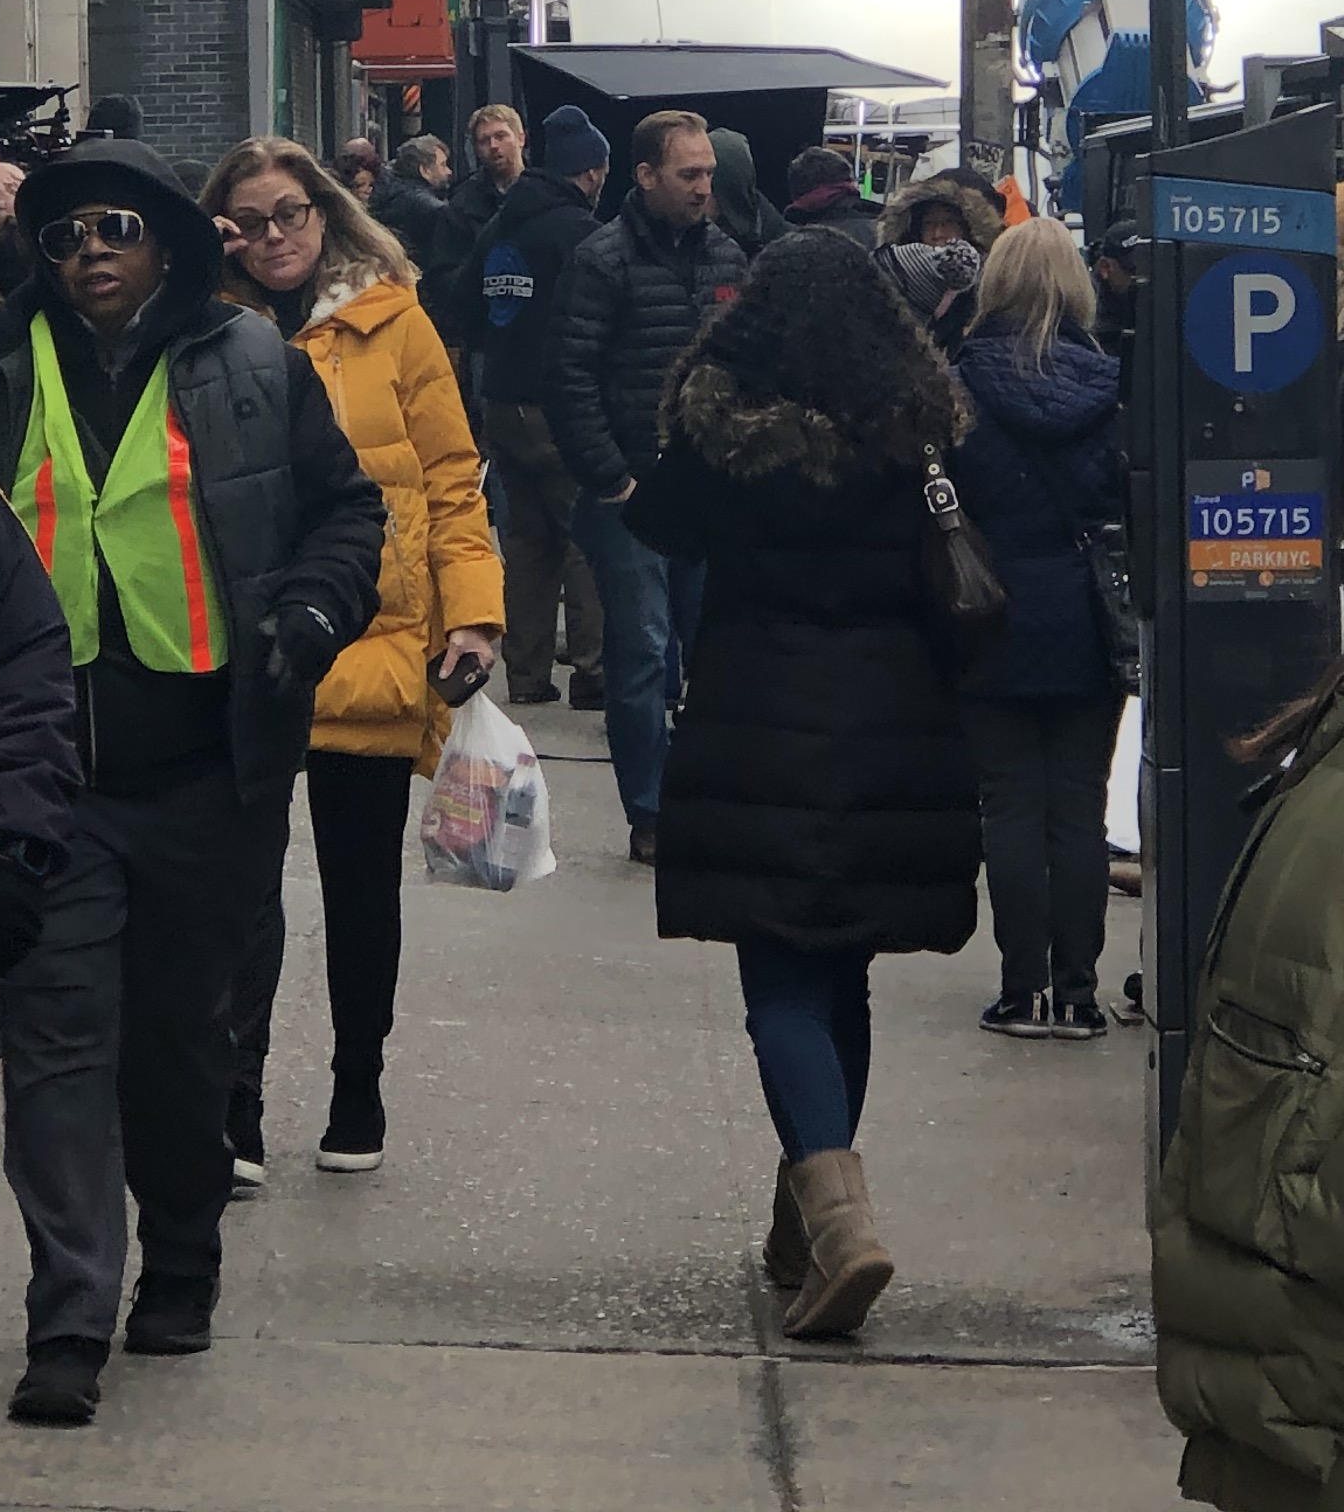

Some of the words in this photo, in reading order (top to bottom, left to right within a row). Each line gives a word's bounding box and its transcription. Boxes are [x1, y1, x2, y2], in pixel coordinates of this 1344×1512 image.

[1171, 204, 1281, 235] 105715
[1233, 274, 1296, 372] P
[1200, 508, 1311, 536] 105715
[1230, 551, 1310, 567] PARKNYC
